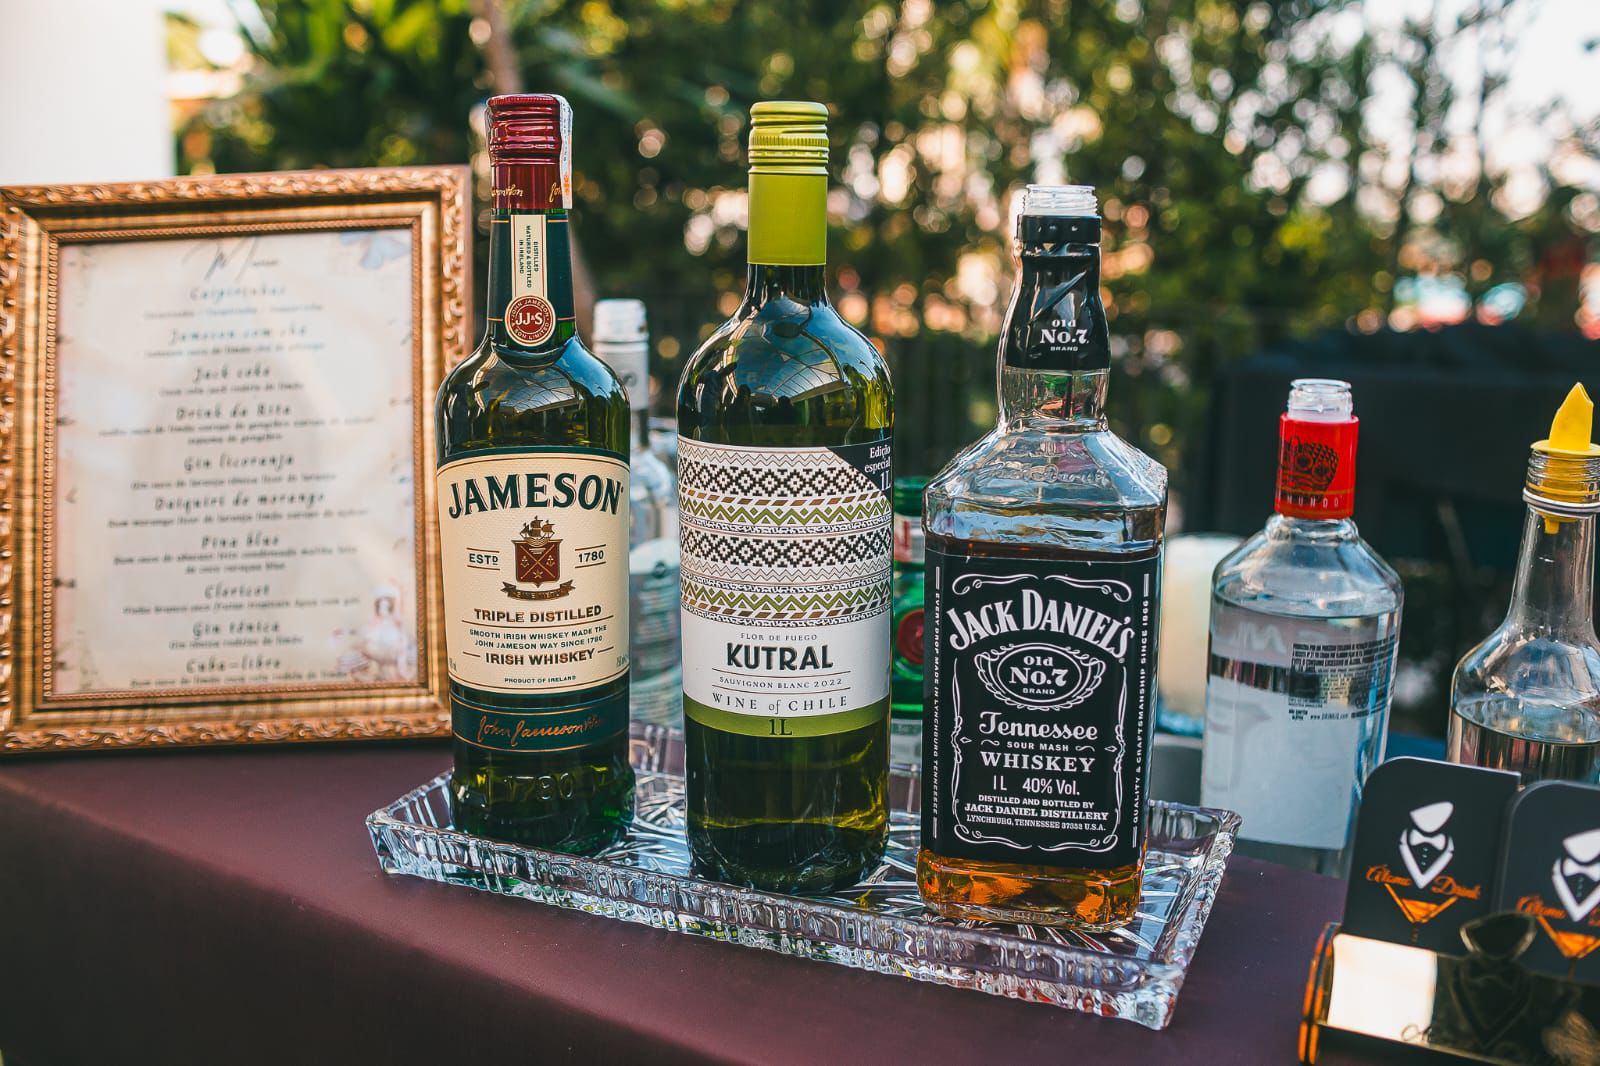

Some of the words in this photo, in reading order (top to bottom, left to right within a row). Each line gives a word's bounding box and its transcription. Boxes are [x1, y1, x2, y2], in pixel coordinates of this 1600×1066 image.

[511, 302, 523, 318] JOHN
[524, 298, 549, 318] JAMESON
[528, 323, 550, 340] LIMITED
[869, 444, 891, 459] Edição
[184, 455, 212, 472] Gin
[864, 456, 891, 475] especial
[448, 472, 622, 519] JAMESON
[578, 550, 604, 563] 1780
[474, 608, 525, 623] TRIPLE
[529, 605, 602, 623] DISTILLED
[469, 628, 501, 640] SMOOTH
[503, 632, 527, 640] IRISH
[528, 631, 569, 641] WHISKEY
[571, 629, 592, 637] MADE
[594, 624, 607, 634] THE
[946, 599, 1020, 651] JACK
[1021, 588, 1136, 659] DANIEL'S
[474, 640, 494, 649] JOHN
[496, 641, 537, 650] JAMESON
[539, 641, 558, 650] WAY
[560, 639, 585, 649] SINCE
[587, 635, 603, 645] 1780
[740, 632, 765, 641] FLOR
[769, 633, 781, 641] DE
[785, 633, 818, 641] FUEGO
[1140, 629, 1148, 664] SINCE
[485, 652, 525, 666] IRISH
[529, 648, 595, 666] WHISKEY
[726, 642, 834, 671] KUTRAL
[548, 675, 577, 683] IRELAND
[719, 676, 773, 689] SAUVIGNON
[777, 681, 810, 689] BLANC
[814, 678, 843, 688] 2022
[1008, 666, 1069, 687] No.7
[933, 686, 939, 697] IN
[1022, 687, 1056, 696] BRAND
[712, 692, 758, 710] WINE
[768, 700, 781, 715] of
[788, 695, 848, 712] CHILE
[1136, 668, 1146, 764] CRAFTSMANSHIP
[477, 715, 511, 743] John
[511, 719, 584, 747] Jameson
[768, 718, 793, 736] 1L
[978, 711, 1098, 740] Tennessee
[1006, 741, 1035, 750] SOUR
[1039, 742, 1069, 752] MASH
[979, 751, 1096, 773] WHISKEY
[1022, 778, 1053, 795] 40%
[1056, 780, 1081, 796] Vol.
[978, 794, 1020, 805] DISTILLED
[1022, 797, 1040, 806] AND
[1042, 799, 1081, 808] BOTTLED
[1082, 801, 1095, 809] BY
[1132, 776, 1141, 824] QUALITY
[964, 803, 994, 814] JACK
[995, 806, 1038, 817] DANIEL
[1040, 809, 1109, 821] DISTILLERY
[966, 814, 1014, 827] LYNCHBURG,
[1015, 818, 1061, 830] TENNESSEE
[1084, 822, 1106, 832] U.S.A.
